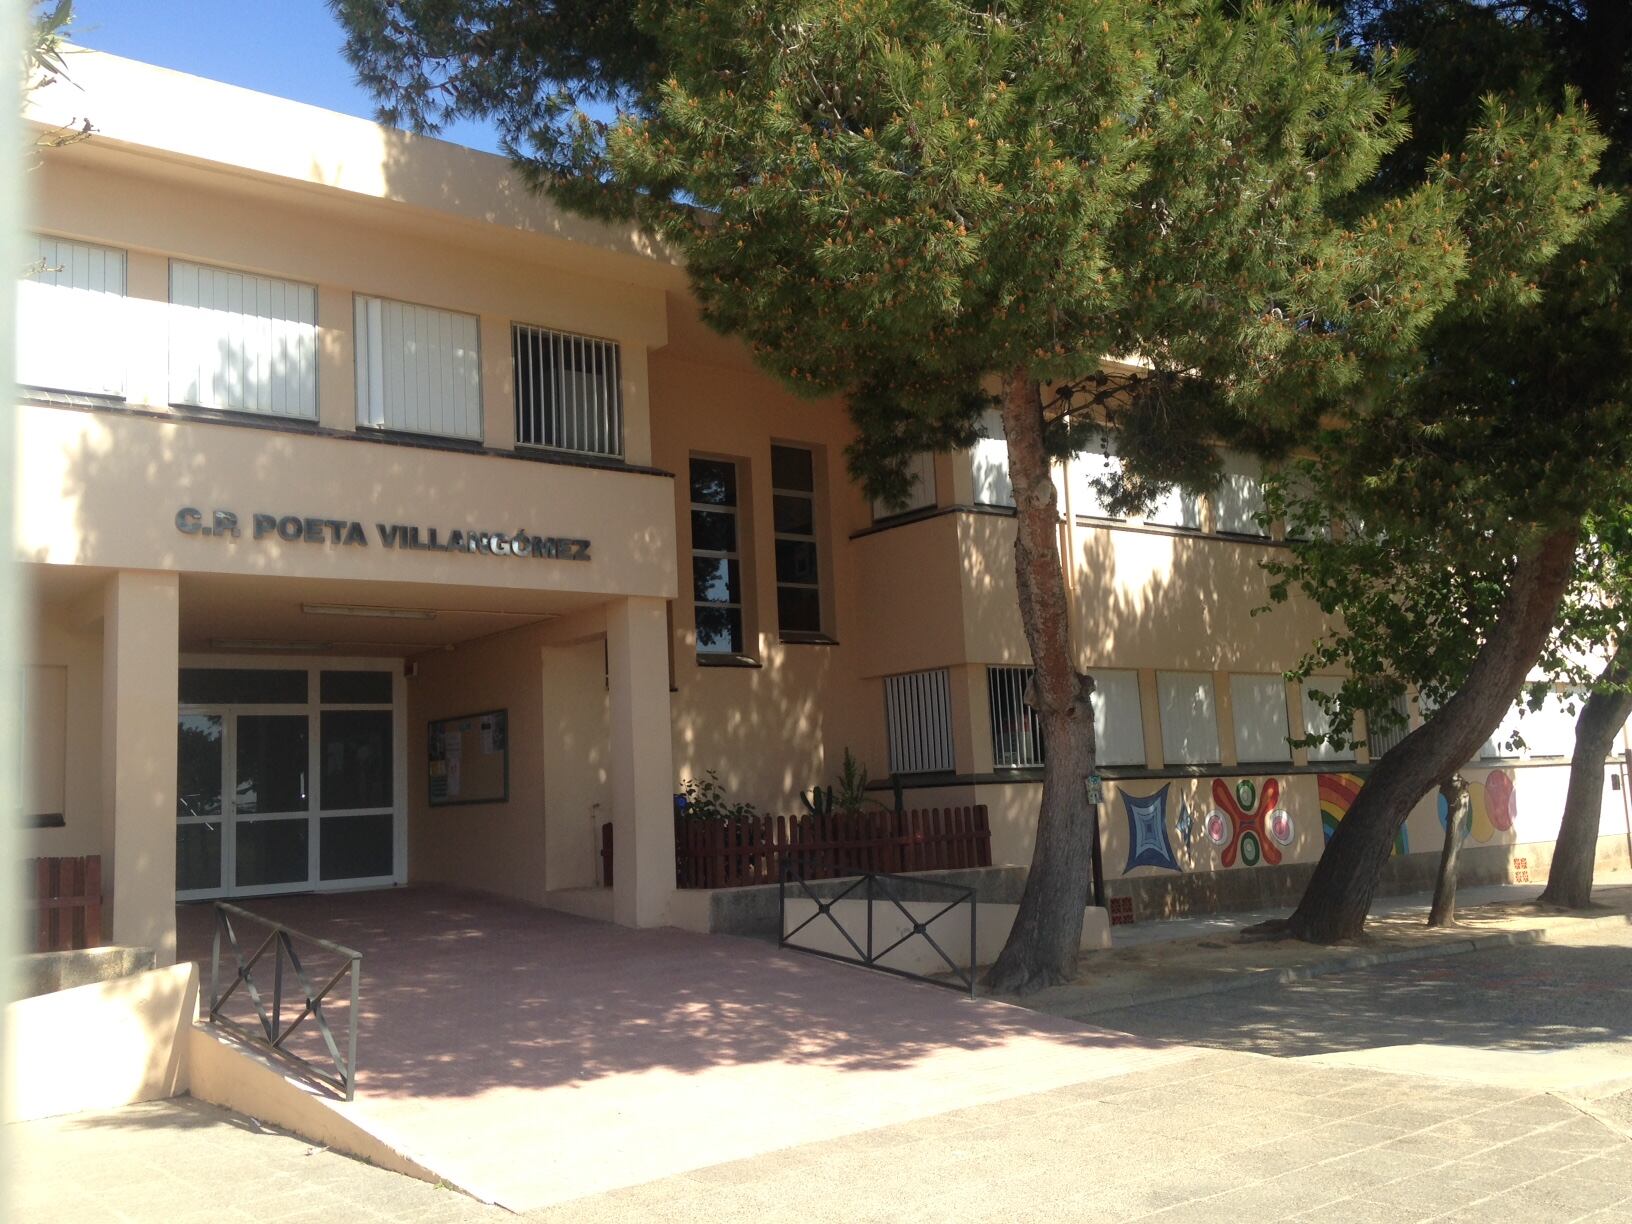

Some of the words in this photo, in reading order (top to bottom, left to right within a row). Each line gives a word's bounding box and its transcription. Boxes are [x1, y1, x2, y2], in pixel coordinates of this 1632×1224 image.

[175, 506, 241, 538] C.P.
[252, 513, 368, 547] POETA
[376, 523, 592, 562] VILLANGÓMEZ
